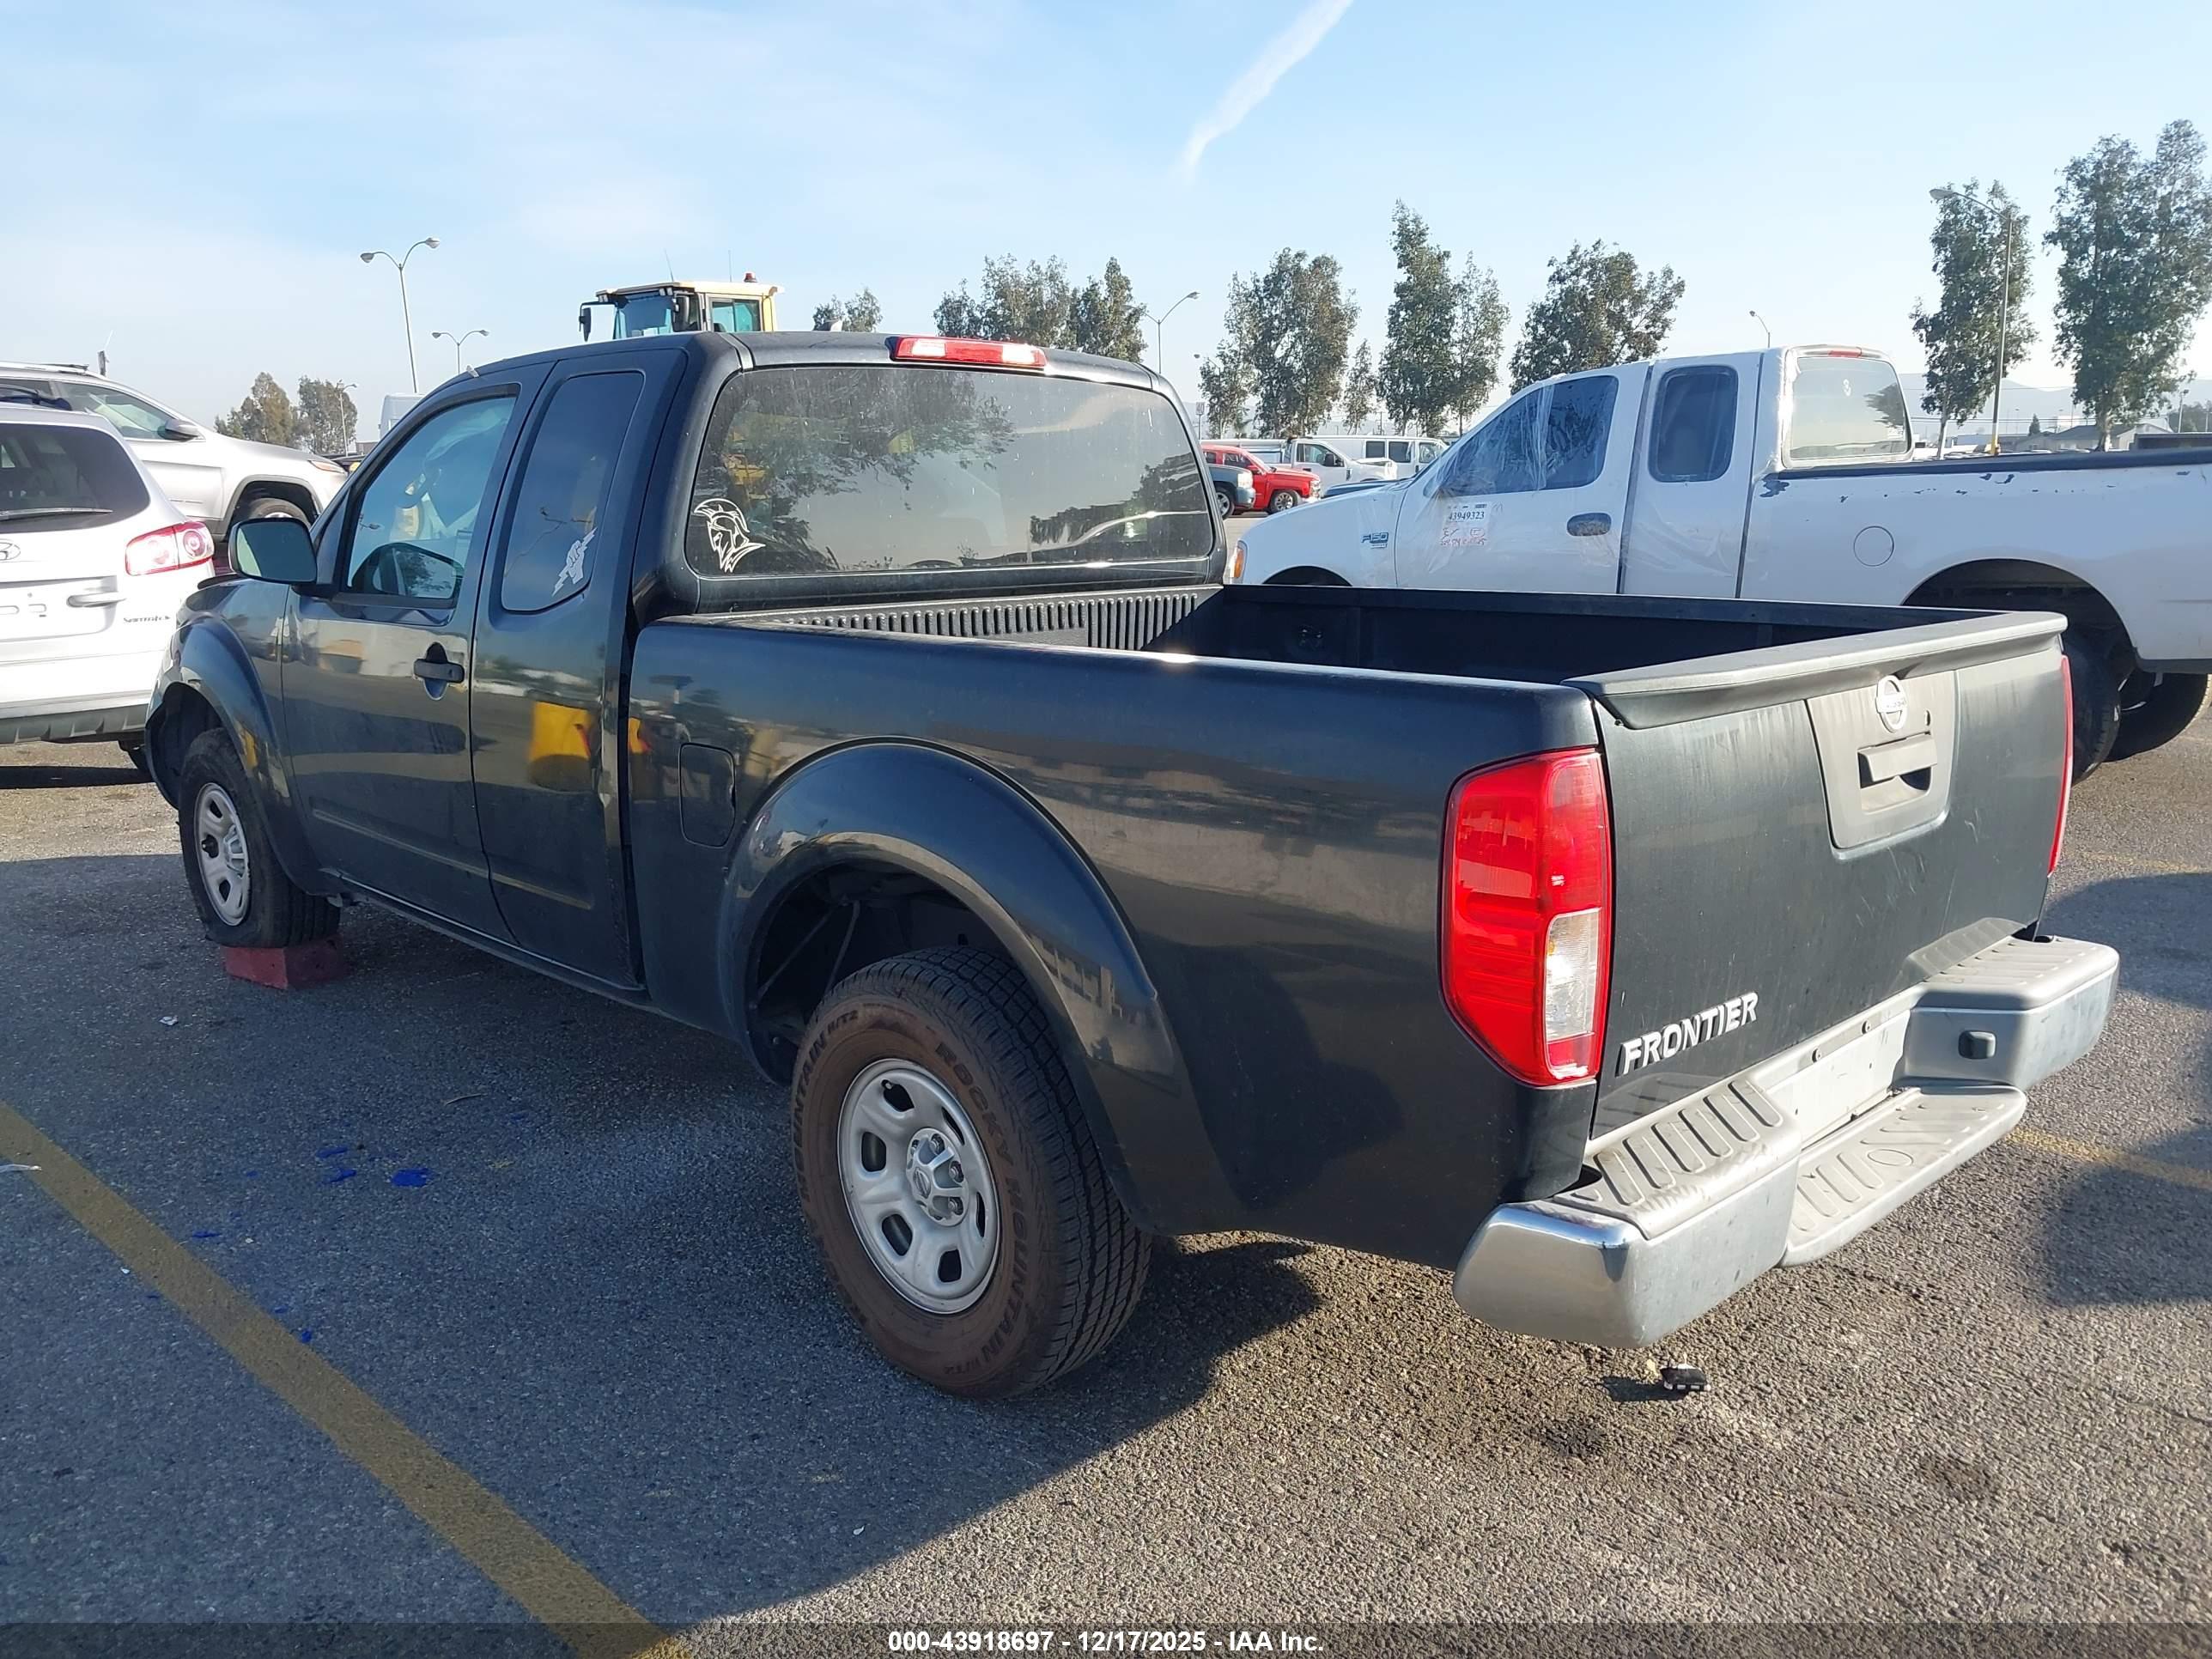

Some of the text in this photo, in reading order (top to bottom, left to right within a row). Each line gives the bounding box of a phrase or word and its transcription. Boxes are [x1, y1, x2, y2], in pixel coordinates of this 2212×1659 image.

[1449, 511, 1485, 520] 43949323
[1615, 992, 1759, 1079] FRONTIER
[935, 1042, 1014, 1166] ROCKY
[981, 1177, 1029, 1361] MOUNTAIN
